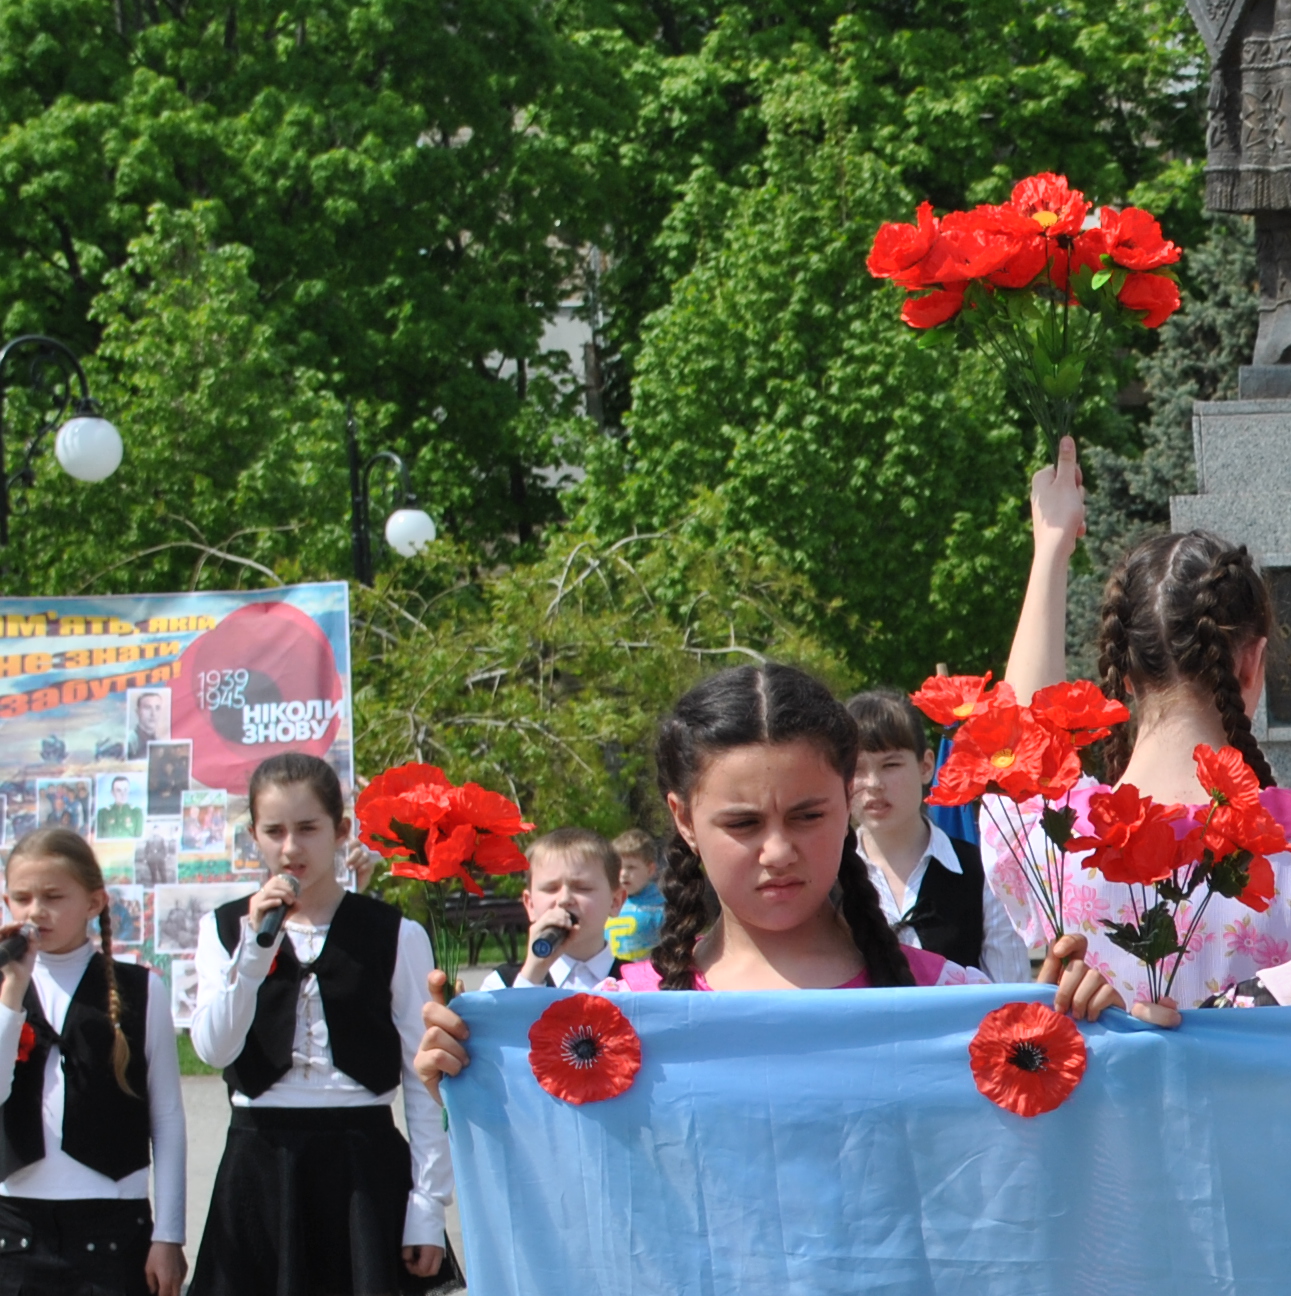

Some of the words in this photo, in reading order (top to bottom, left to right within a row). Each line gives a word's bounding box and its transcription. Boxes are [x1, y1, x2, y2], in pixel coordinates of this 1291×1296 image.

[197, 668, 249, 691] 1939
[197, 686, 247, 711] 1945
[242, 699, 346, 724] НІКОЛИ
[242, 719, 330, 745] ЗНОВУ
